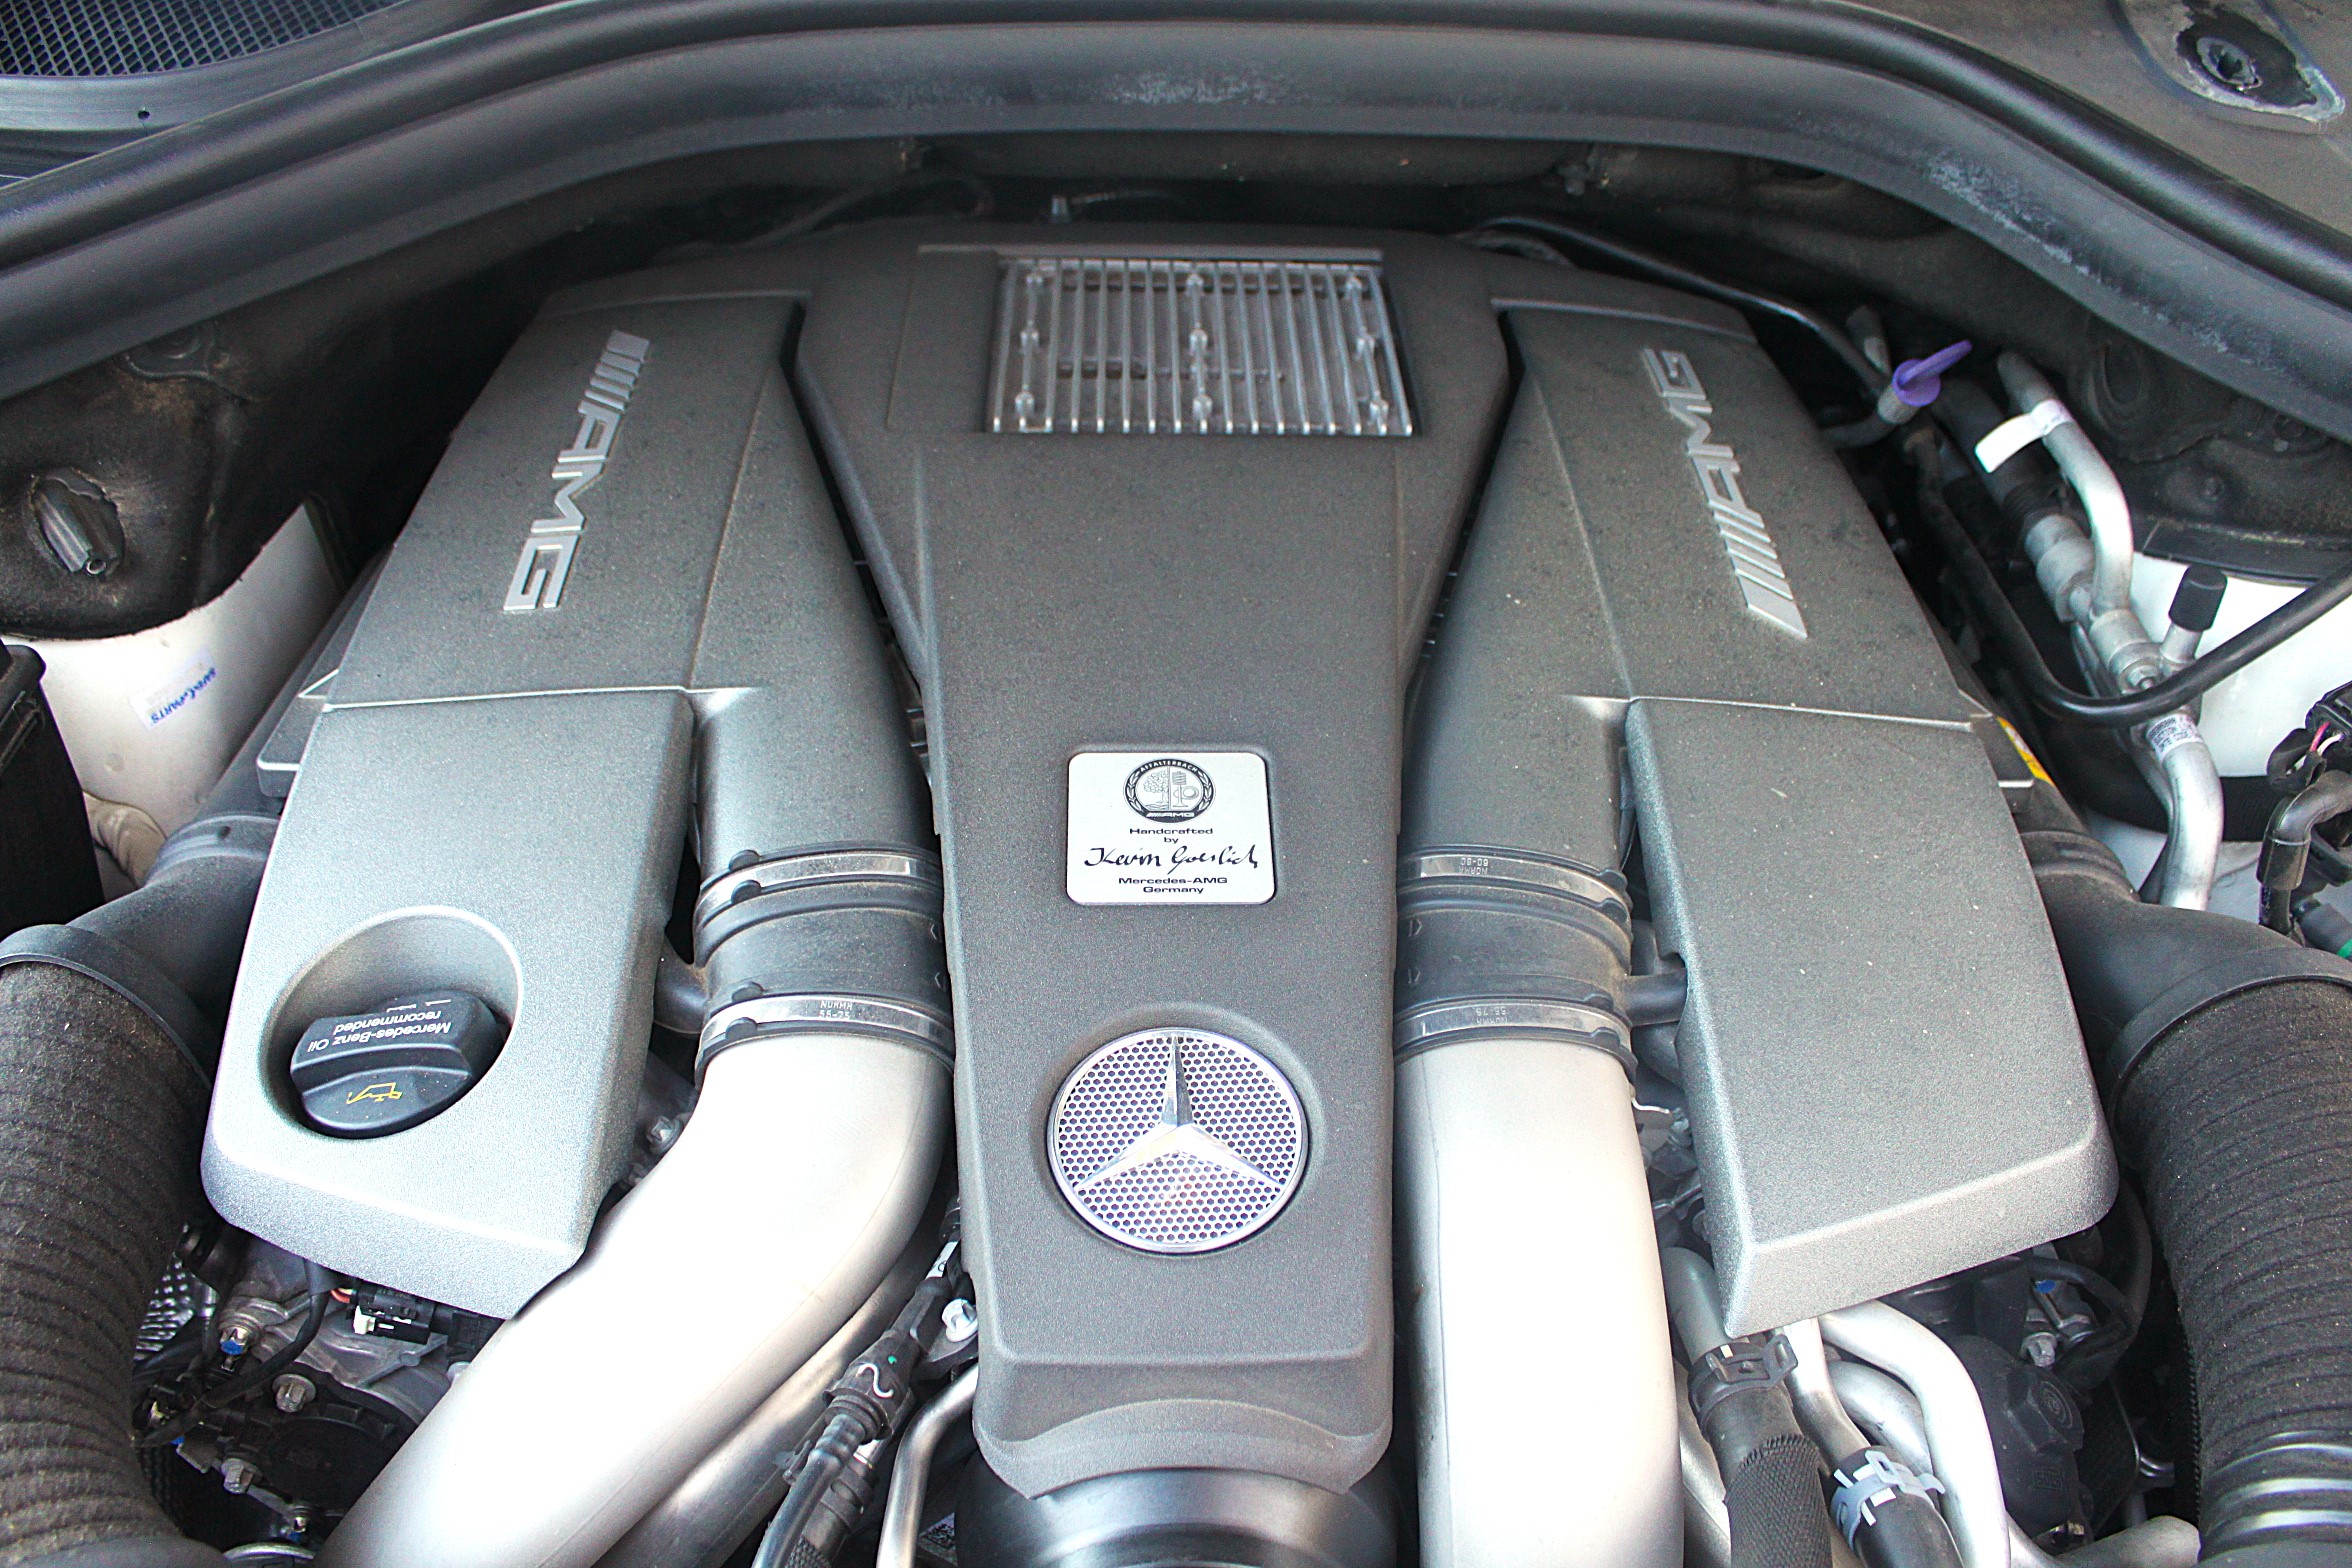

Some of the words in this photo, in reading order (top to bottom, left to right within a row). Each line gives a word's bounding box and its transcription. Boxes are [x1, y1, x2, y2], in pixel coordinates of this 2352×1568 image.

[1140, 760, 1198, 773] AFFALTERBACH
[1084, 847, 1161, 867] Kevin
[1118, 877, 1228, 885] Mercedes-AMG
[1143, 886, 1204, 895] Germany
[333, 1010, 442, 1036] recommended
[332, 1022, 452, 1046] Mercedes-Benz
[307, 1038, 329, 1053] Oil
